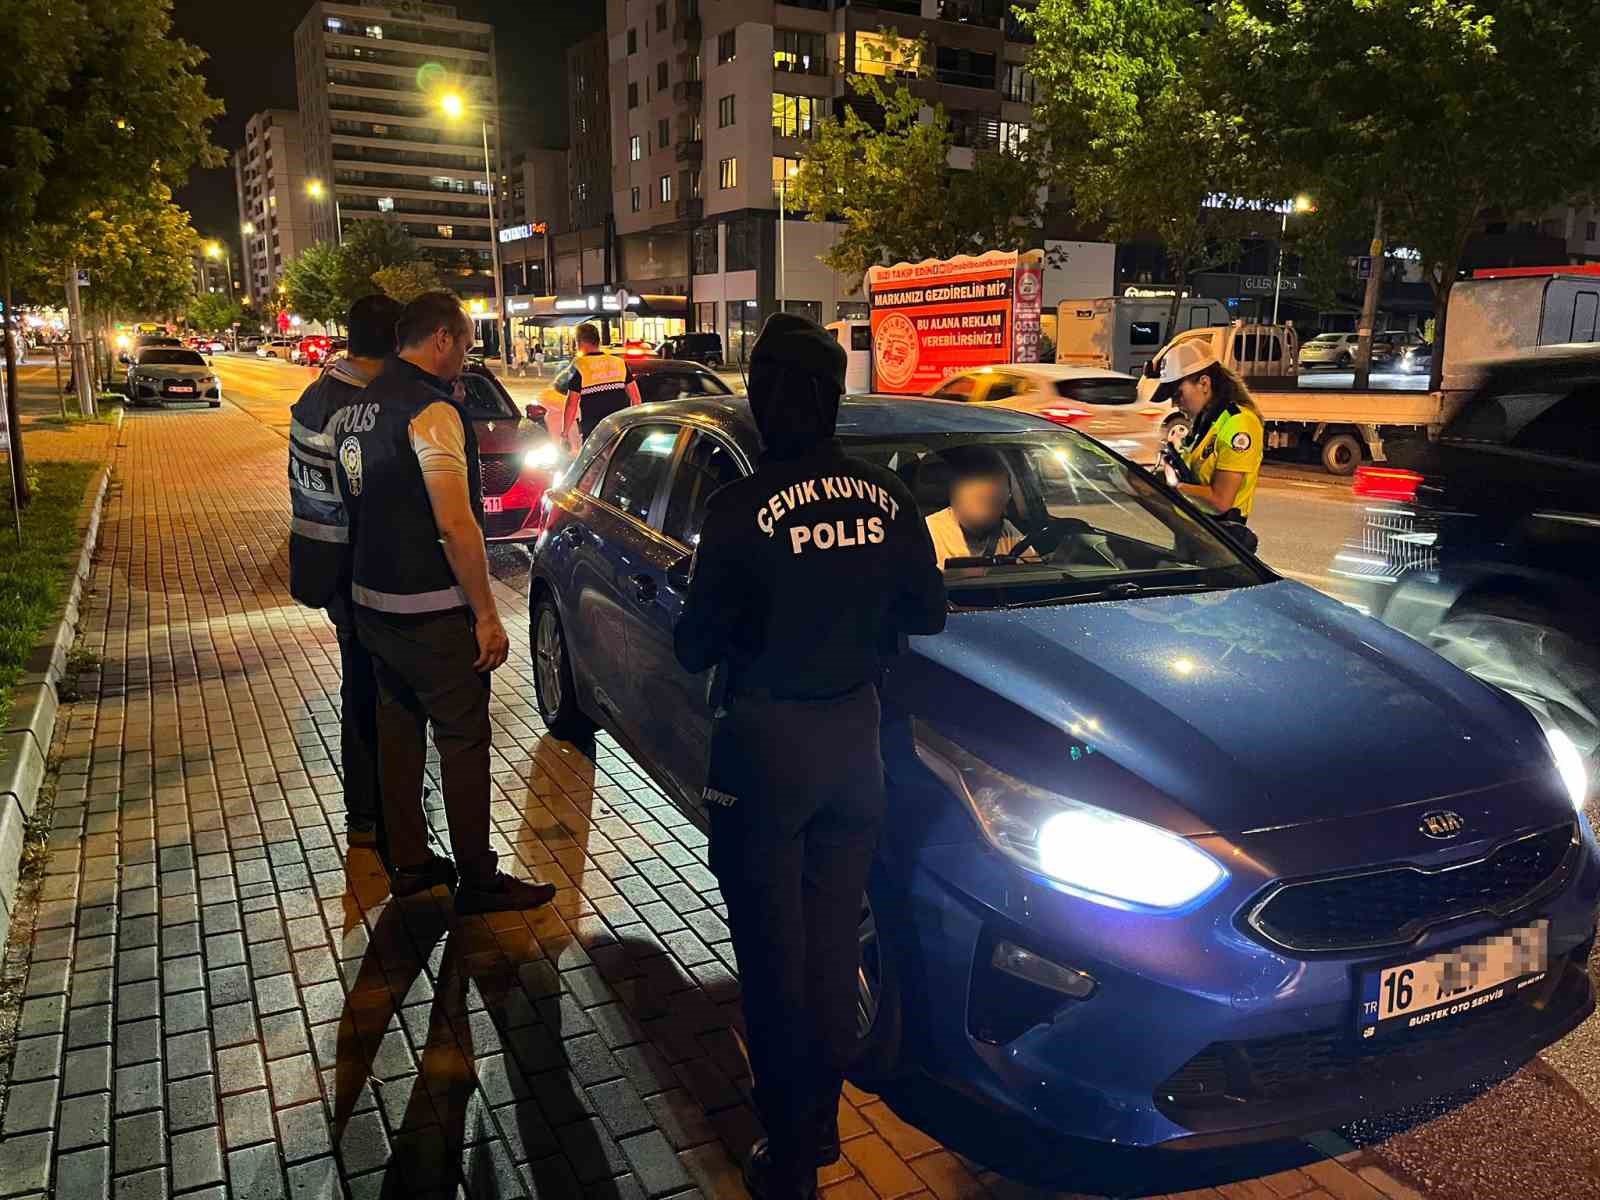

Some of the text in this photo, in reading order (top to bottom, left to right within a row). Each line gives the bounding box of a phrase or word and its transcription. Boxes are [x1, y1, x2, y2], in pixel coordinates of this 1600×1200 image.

[874, 291, 924, 306] MARKANIZI
[925, 282, 985, 301] GEZDİRELİM
[917, 314, 1001, 330] BU ALANA REKLAM
[1017, 346, 1037, 362] 25
[757, 476, 899, 538] ÇEVİK KUVVET
[789, 516, 885, 554] POLİS
[1426, 815, 1461, 834] KIA
[1384, 968, 1414, 1013] 16
[1363, 1001, 1378, 1014] TR
[1408, 1007, 1449, 1027] BURTEK
[1450, 1002, 1470, 1015] OTO
